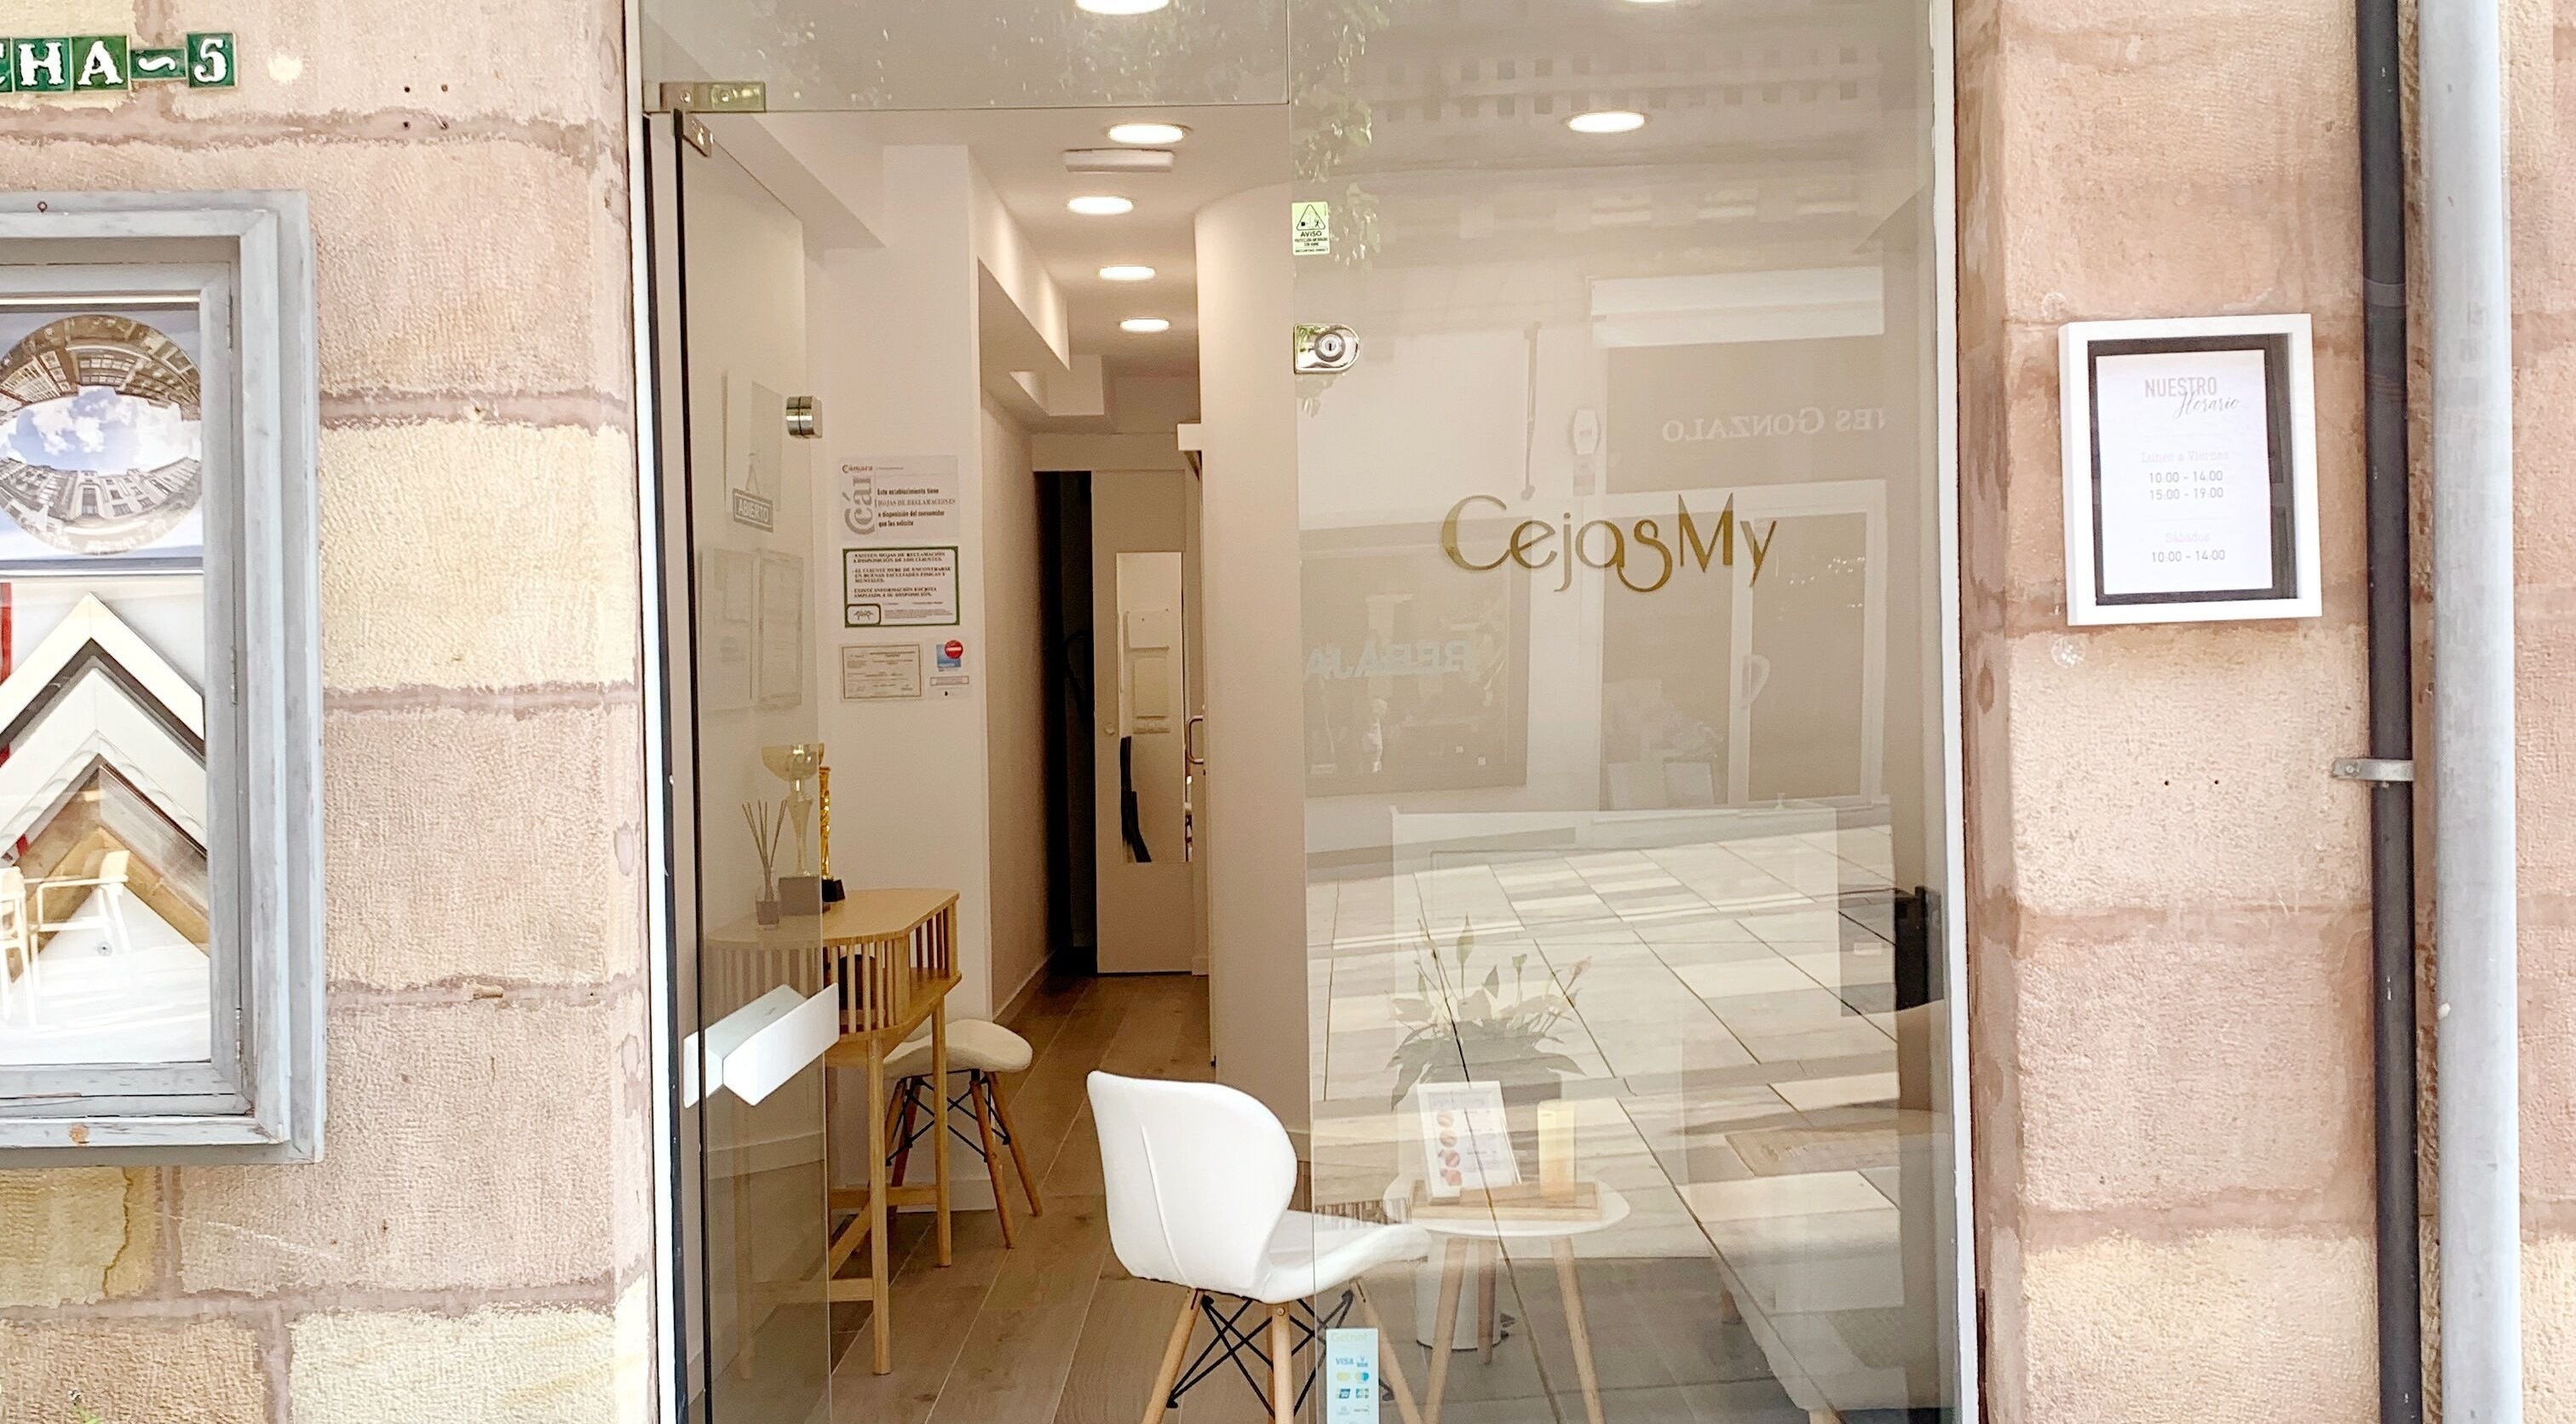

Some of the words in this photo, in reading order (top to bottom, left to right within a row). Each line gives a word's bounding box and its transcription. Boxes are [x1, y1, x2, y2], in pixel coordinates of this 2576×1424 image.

[194, 38, 227, 83] 5
[2144, 376, 2217, 398] NUESTRO
[2173, 391, 2240, 420] Horario
[739, 498, 769, 522] ABIERTO
[1441, 492, 1777, 593] CejasMy
[1336, 1357, 1354, 1366] VISA
